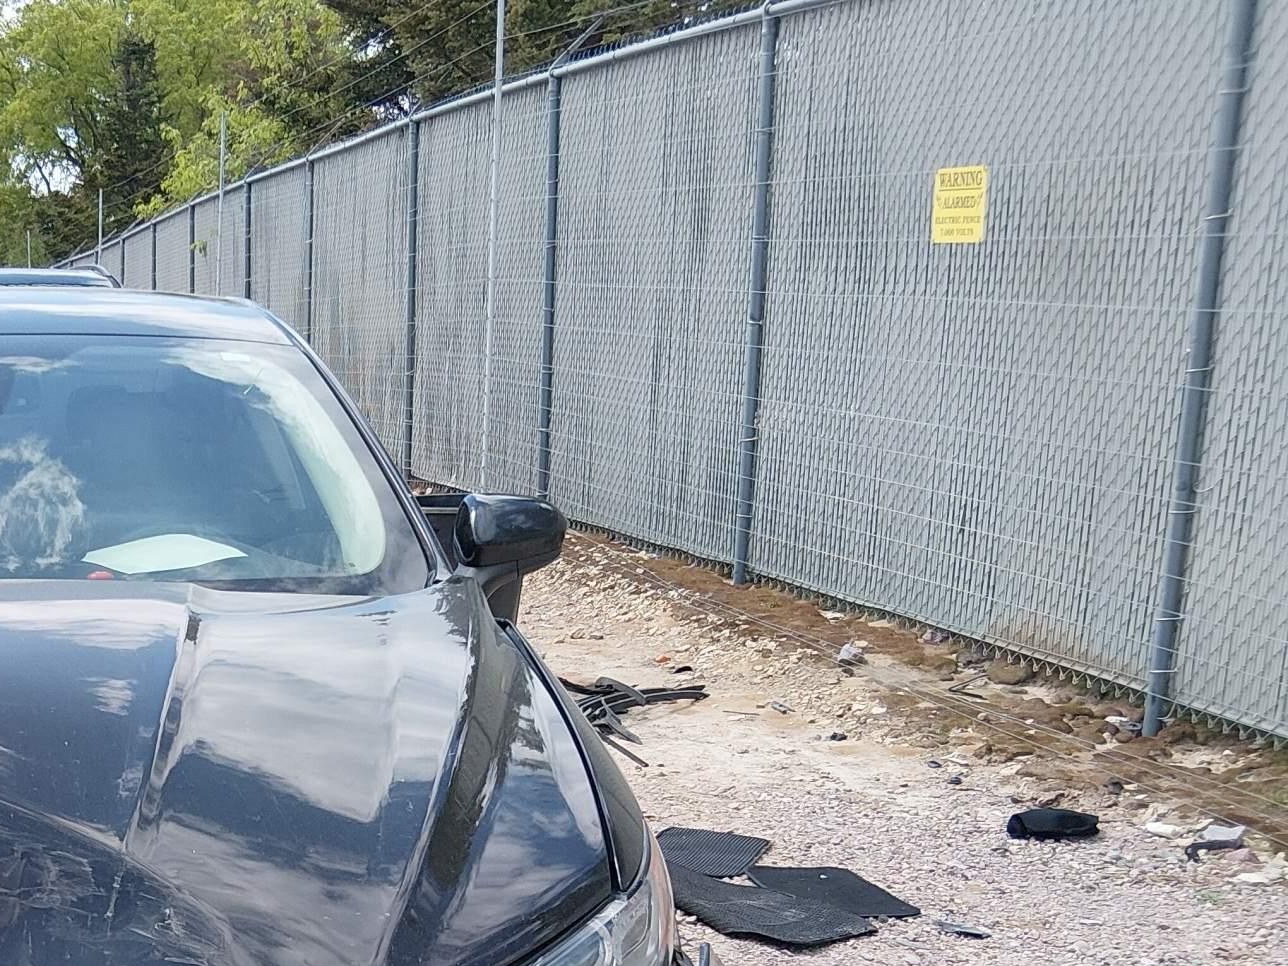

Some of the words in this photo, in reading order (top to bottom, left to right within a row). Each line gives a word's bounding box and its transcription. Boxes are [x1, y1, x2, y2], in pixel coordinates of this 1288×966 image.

[939, 170, 983, 188] WARNING
[943, 195, 977, 209] ALARMED
[935, 215, 961, 224] ELECTRIC
[962, 215, 981, 224] FENCE
